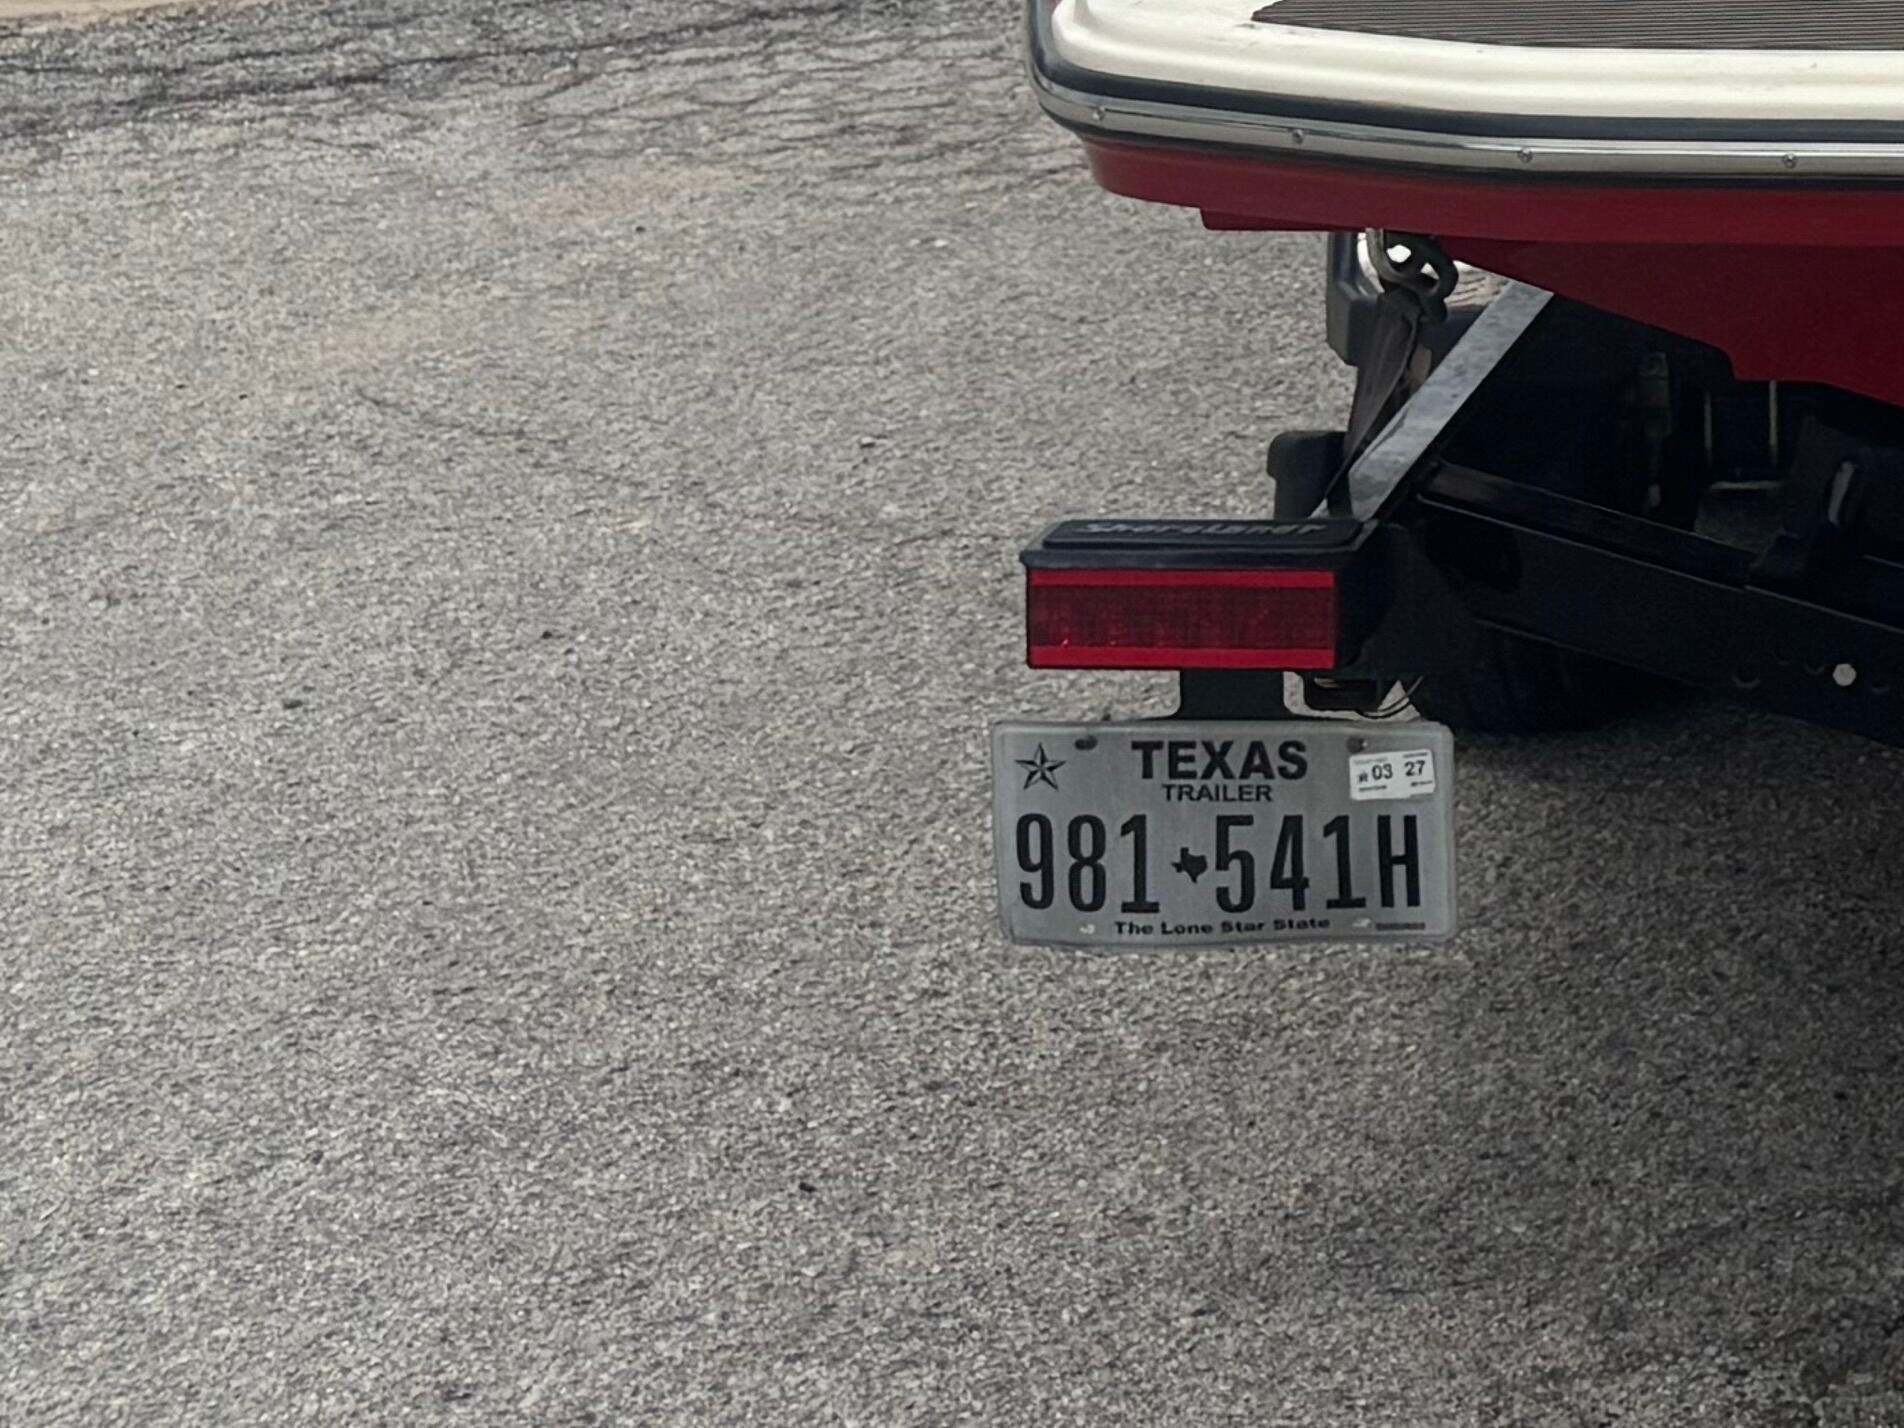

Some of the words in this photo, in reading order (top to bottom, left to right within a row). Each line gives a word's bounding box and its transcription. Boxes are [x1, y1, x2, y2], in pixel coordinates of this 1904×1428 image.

[1131, 740, 1308, 781] TEXAS
[1372, 763, 1393, 780] 03
[1404, 760, 1426, 776] 27
[1163, 784, 1273, 803] TRAILER
[1114, 921, 1153, 935] The
[1161, 920, 1213, 935] Lone
[1221, 919, 1265, 933] Star
[1273, 917, 1331, 931] State
